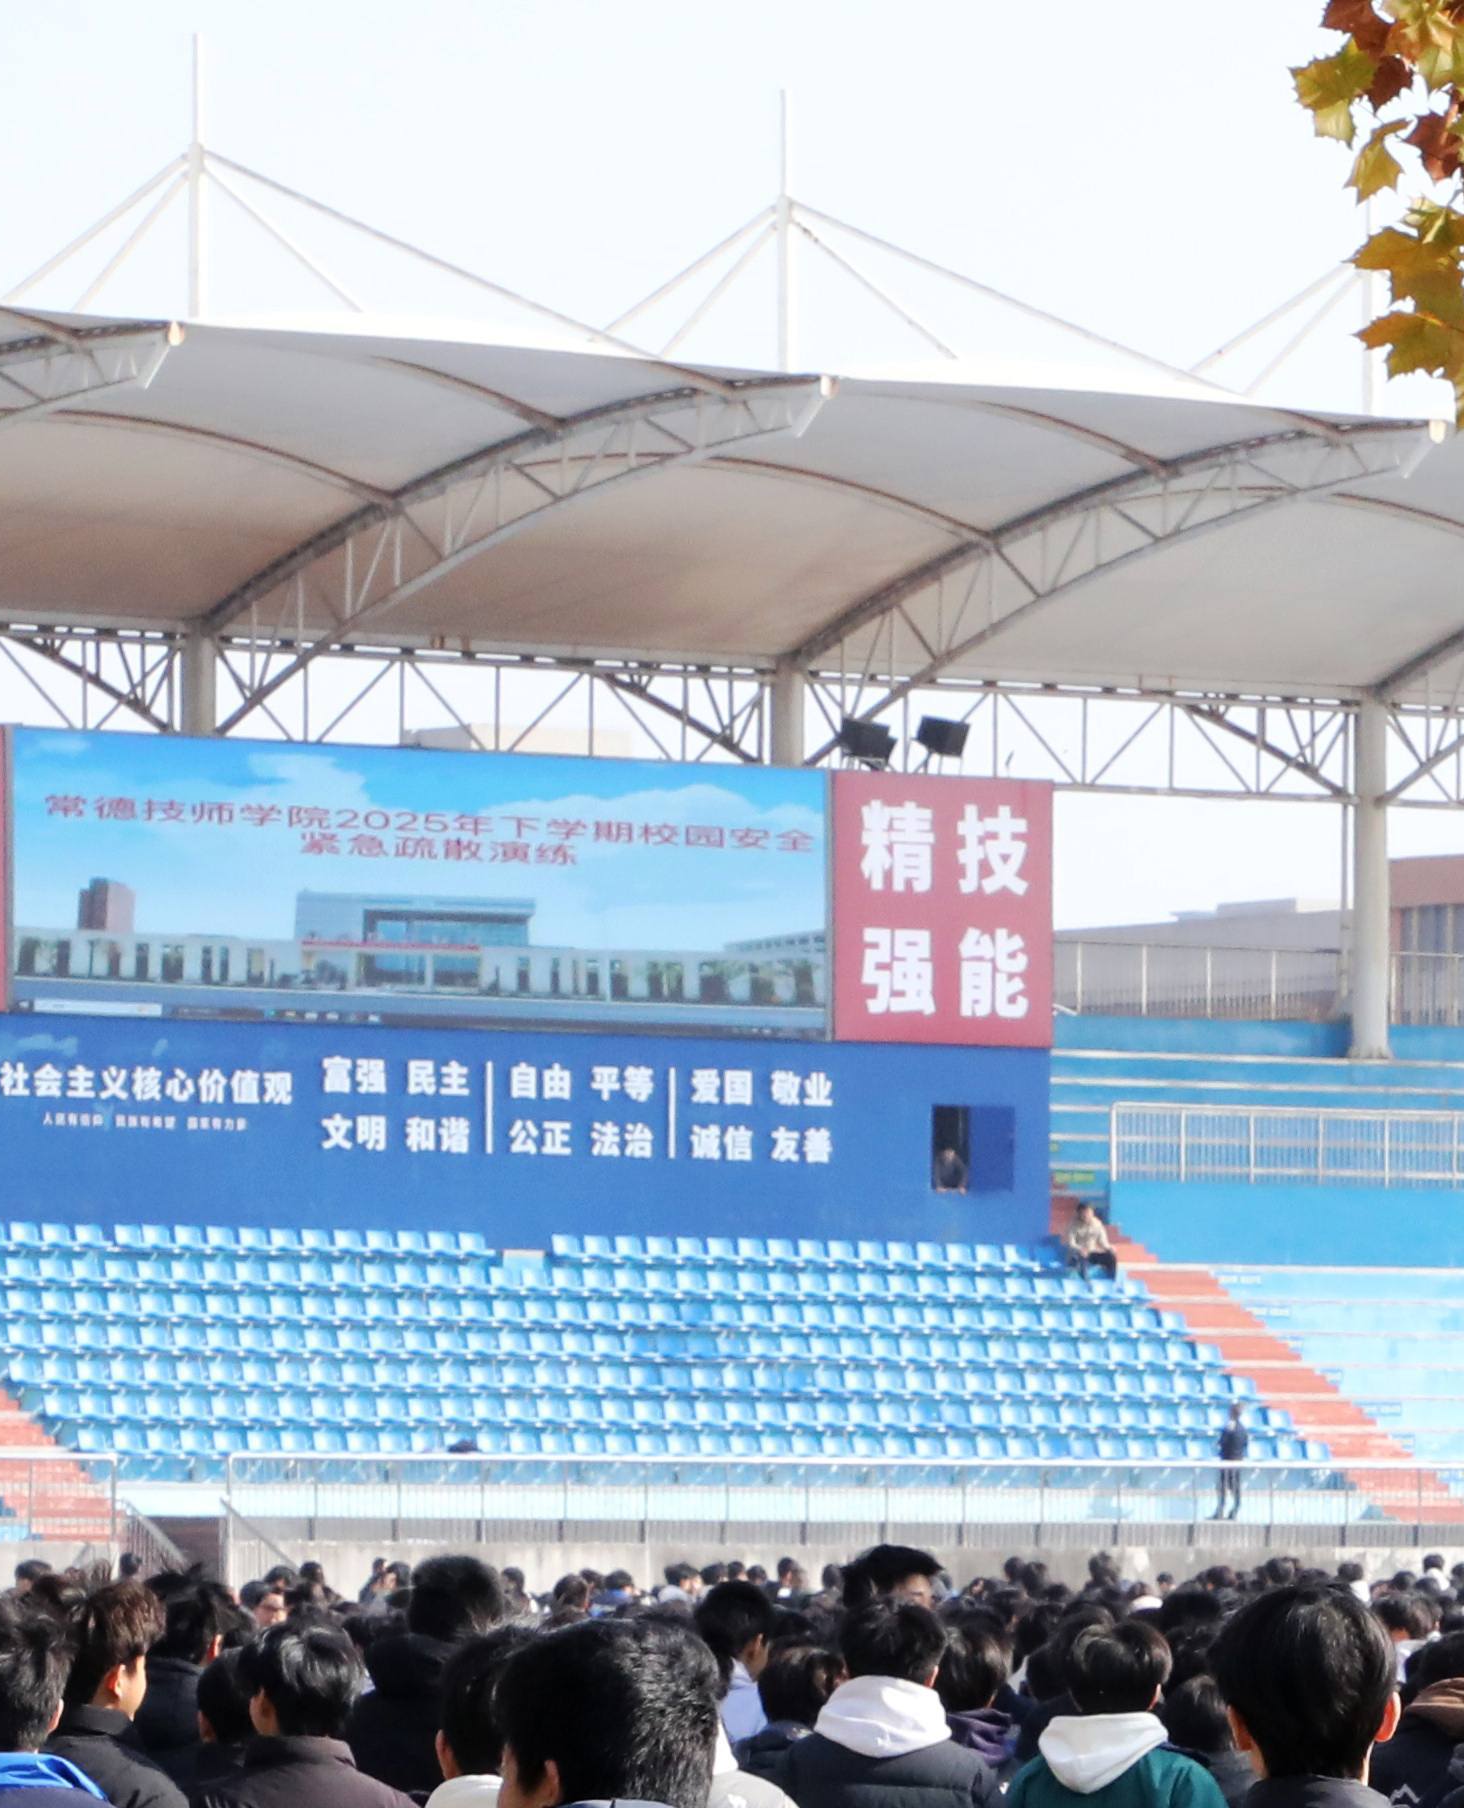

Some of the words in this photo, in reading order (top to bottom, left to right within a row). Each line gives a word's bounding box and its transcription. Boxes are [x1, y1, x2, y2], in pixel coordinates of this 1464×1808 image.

[45, 794, 814, 853] 常德技师学院2025年下学期校园安全
[300, 832, 577, 866] 紧急疏散演练
[860, 799, 1029, 896] 精技
[861, 927, 1029, 1019] 强能
[0, 1061, 293, 1105] 社会主义核心价值观
[322, 1056, 387, 1094] 富强
[407, 1059, 470, 1096] 民主
[510, 1062, 572, 1100] 自由
[590, 1065, 654, 1103] 平等
[691, 1068, 753, 1106] 爱国
[770, 1070, 833, 1107] 敬业
[321, 1113, 387, 1152] 文明
[405, 1116, 470, 1154] 和谐
[509, 1119, 572, 1156] 公正
[590, 1120, 654, 1159] 法治
[690, 1124, 753, 1161] 诚信
[771, 1125, 833, 1164] 友善
